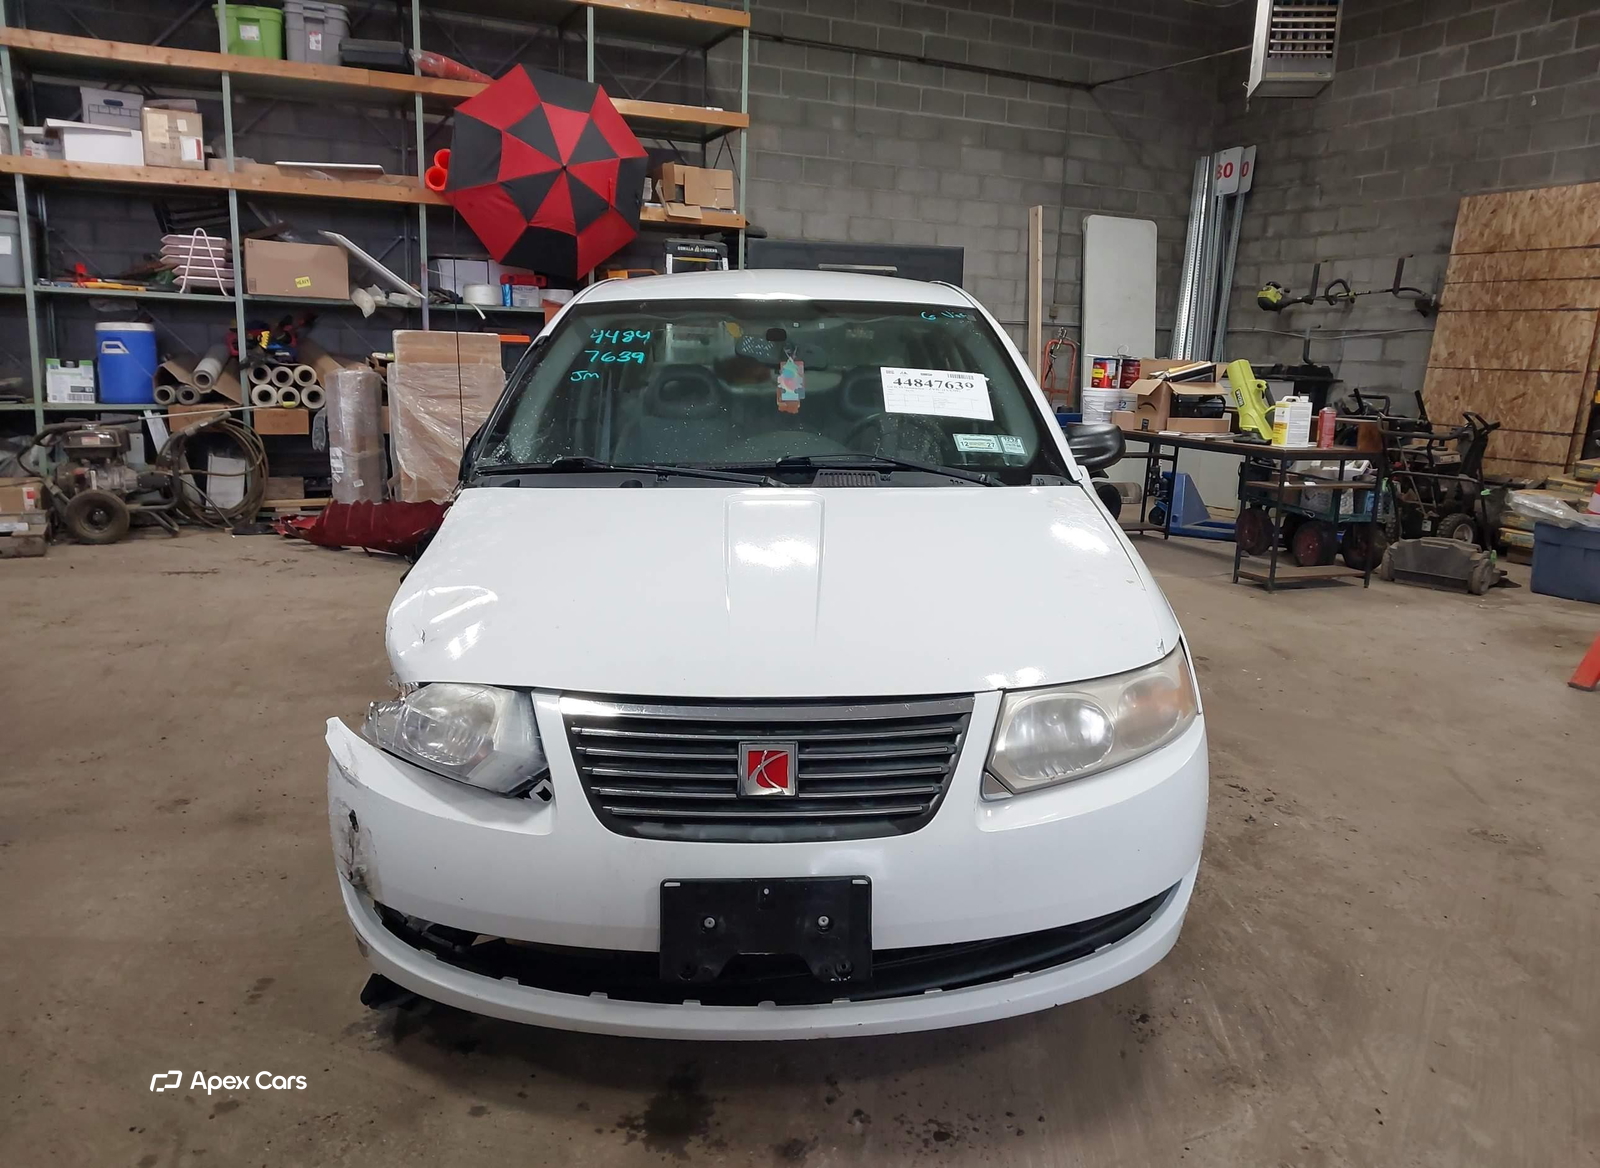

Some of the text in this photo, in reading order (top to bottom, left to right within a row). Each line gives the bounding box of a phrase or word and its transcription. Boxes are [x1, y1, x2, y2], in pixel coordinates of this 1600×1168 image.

[590, 328, 651, 345] 4484
[584, 350, 645, 364] 7639
[893, 378, 974, 390] 44847639
